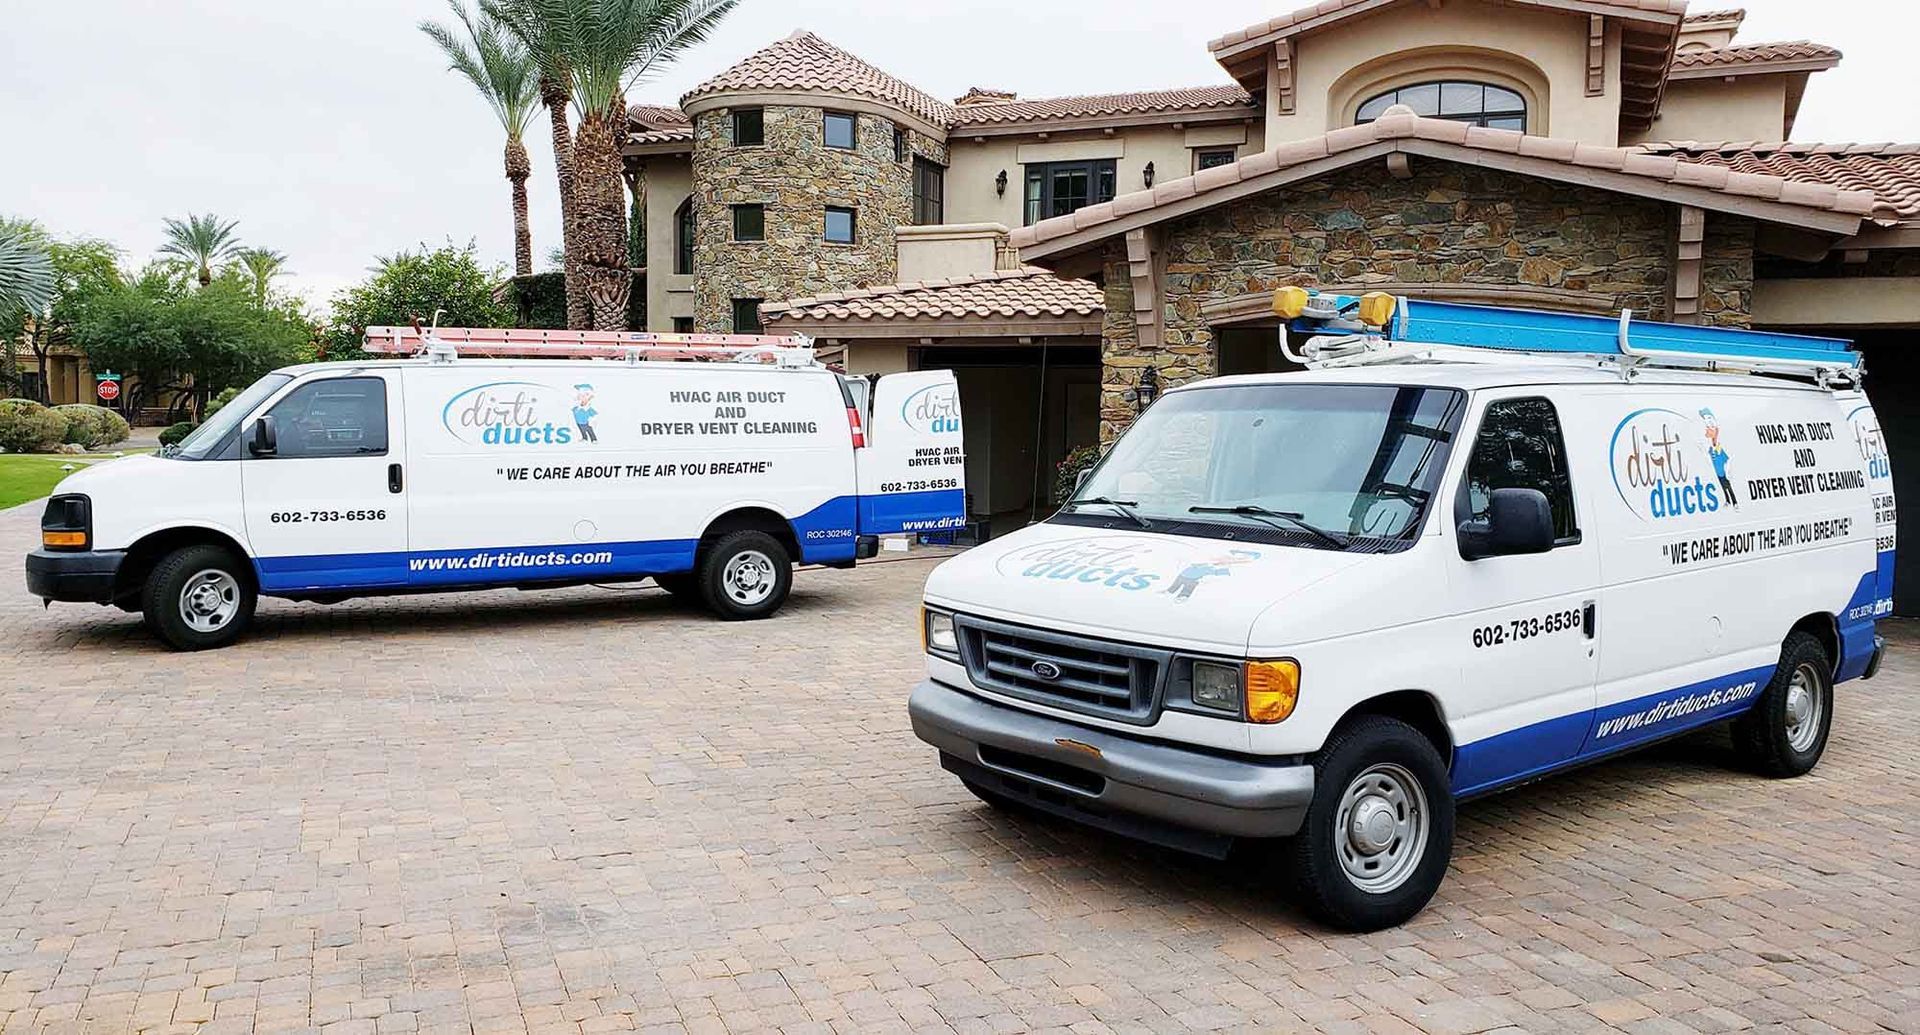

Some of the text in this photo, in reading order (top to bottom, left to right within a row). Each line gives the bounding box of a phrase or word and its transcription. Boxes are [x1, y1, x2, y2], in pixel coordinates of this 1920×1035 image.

[100, 386, 117, 394] STOP
[669, 391, 786, 403] HVAC AIR DUCT
[460, 391, 538, 427] dirti
[715, 406, 747, 419] AND
[482, 422, 572, 445] ducts
[641, 421, 818, 435] DRYER VENT CLEANING
[1755, 422, 1835, 444] HVAC AIR DUCT
[908, 456, 941, 467] DRYER
[915, 446, 960, 457] HVAC AIR
[1627, 423, 1689, 488] dirti
[1793, 448, 1816, 469] AND
[533, 467, 571, 480] CARE
[574, 465, 622, 479] ABOUT
[625, 465, 651, 477] THE
[654, 464, 676, 477] AIR
[680, 463, 707, 475] YOU
[710, 461, 773, 475] BREATHE"
[880, 478, 957, 492] 602-733-6536
[1748, 469, 1865, 500] DRYER VENT CLEANING
[1650, 476, 1719, 518] ducts
[1882, 495, 1894, 507] AIR
[270, 509, 387, 523] 602-733-6536
[806, 529, 852, 539] ROC 302146
[1691, 537, 1719, 562] CARE
[1722, 531, 1755, 556] ABOUT
[1757, 528, 1776, 550] THE
[1777, 526, 1793, 547] AIR
[1794, 523, 1812, 544] YOU
[408, 551, 613, 571] www.dirtiducts.com
[1022, 559, 1160, 591] ducts
[1473, 608, 1581, 648] 602-733-6536
[1596, 681, 1757, 739] www.dirtiducts.com
